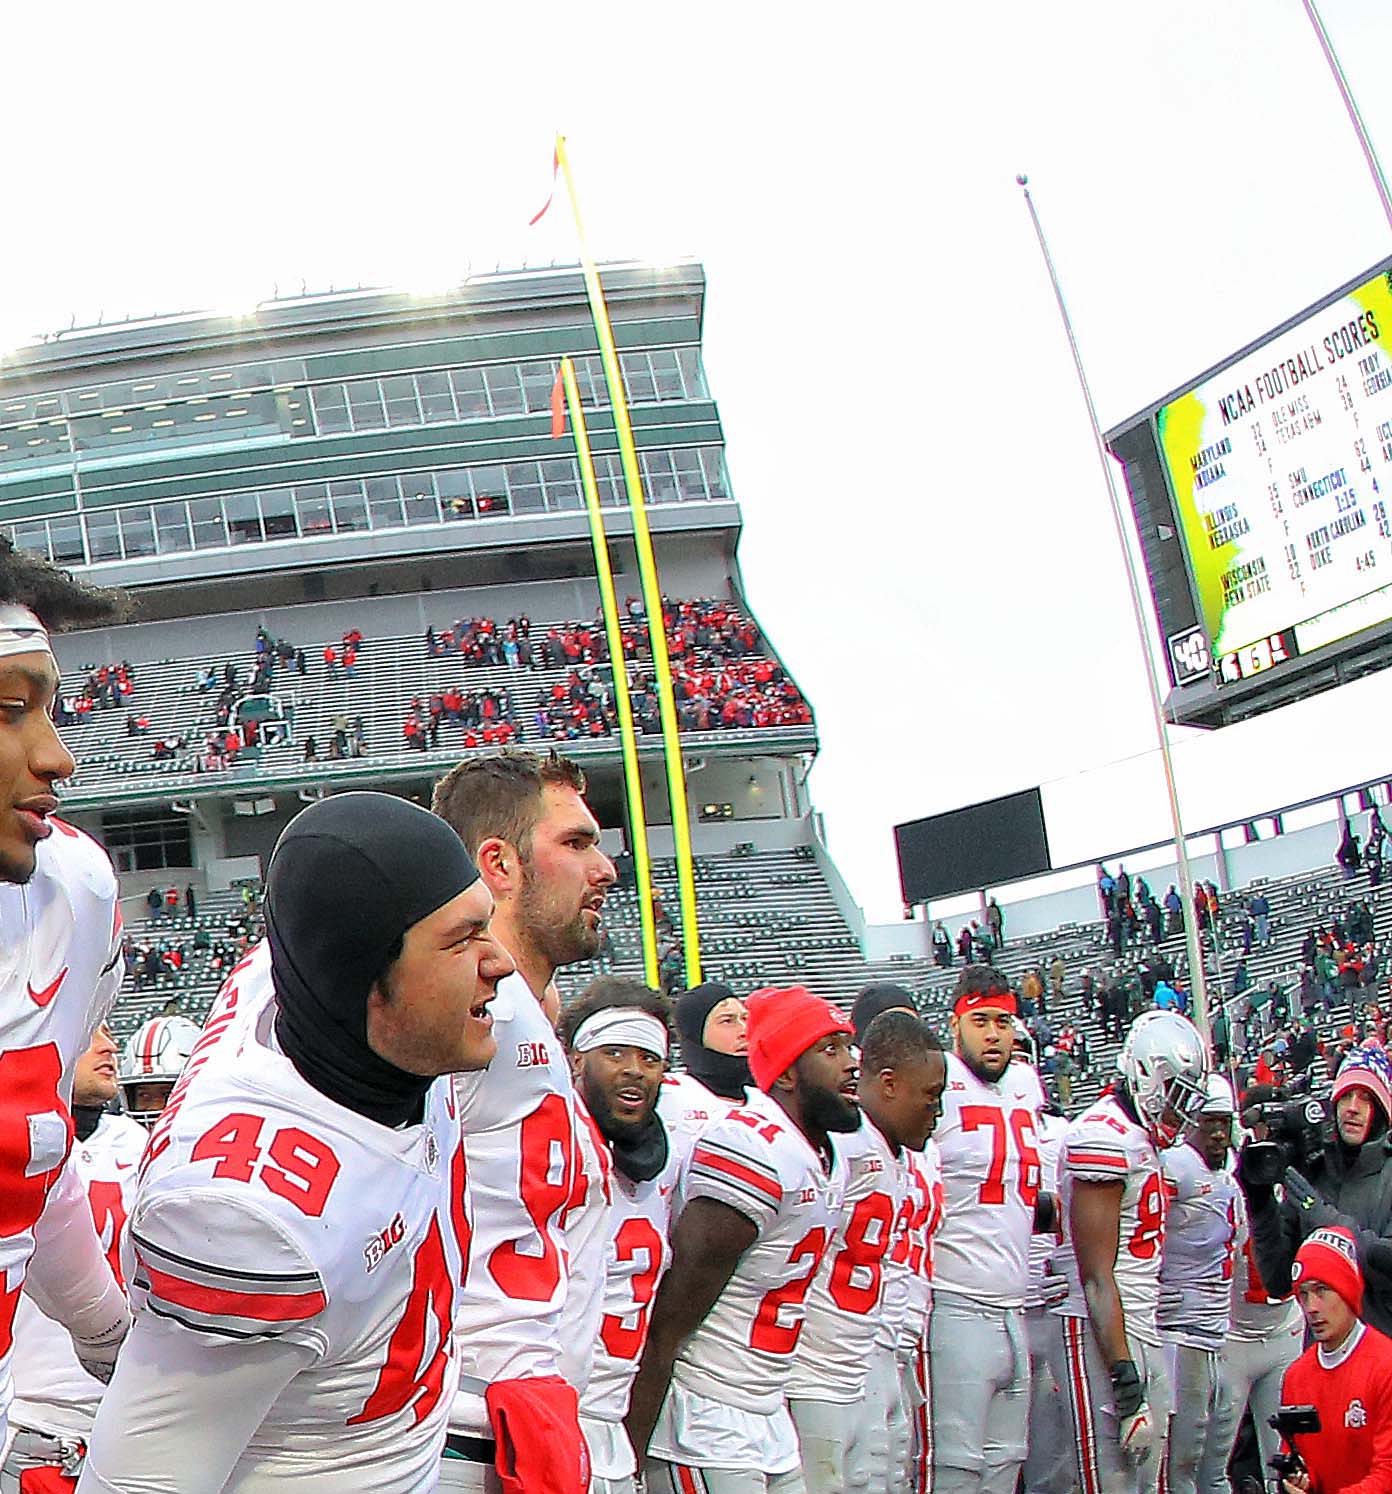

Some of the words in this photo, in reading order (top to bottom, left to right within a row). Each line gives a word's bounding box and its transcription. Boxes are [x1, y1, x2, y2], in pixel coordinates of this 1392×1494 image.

[1218, 384, 1256, 426] NCAA
[1256, 345, 1325, 404] FOOTBALL
[1323, 310, 1380, 364] SCORES
[1288, 394, 1310, 418] MISS
[1190, 436, 1232, 473] MARYLAND
[1292, 467, 1348, 509] CONNECTICUT
[1221, 556, 1266, 591] WISCONSIN
[190, 1112, 341, 1218] 49
